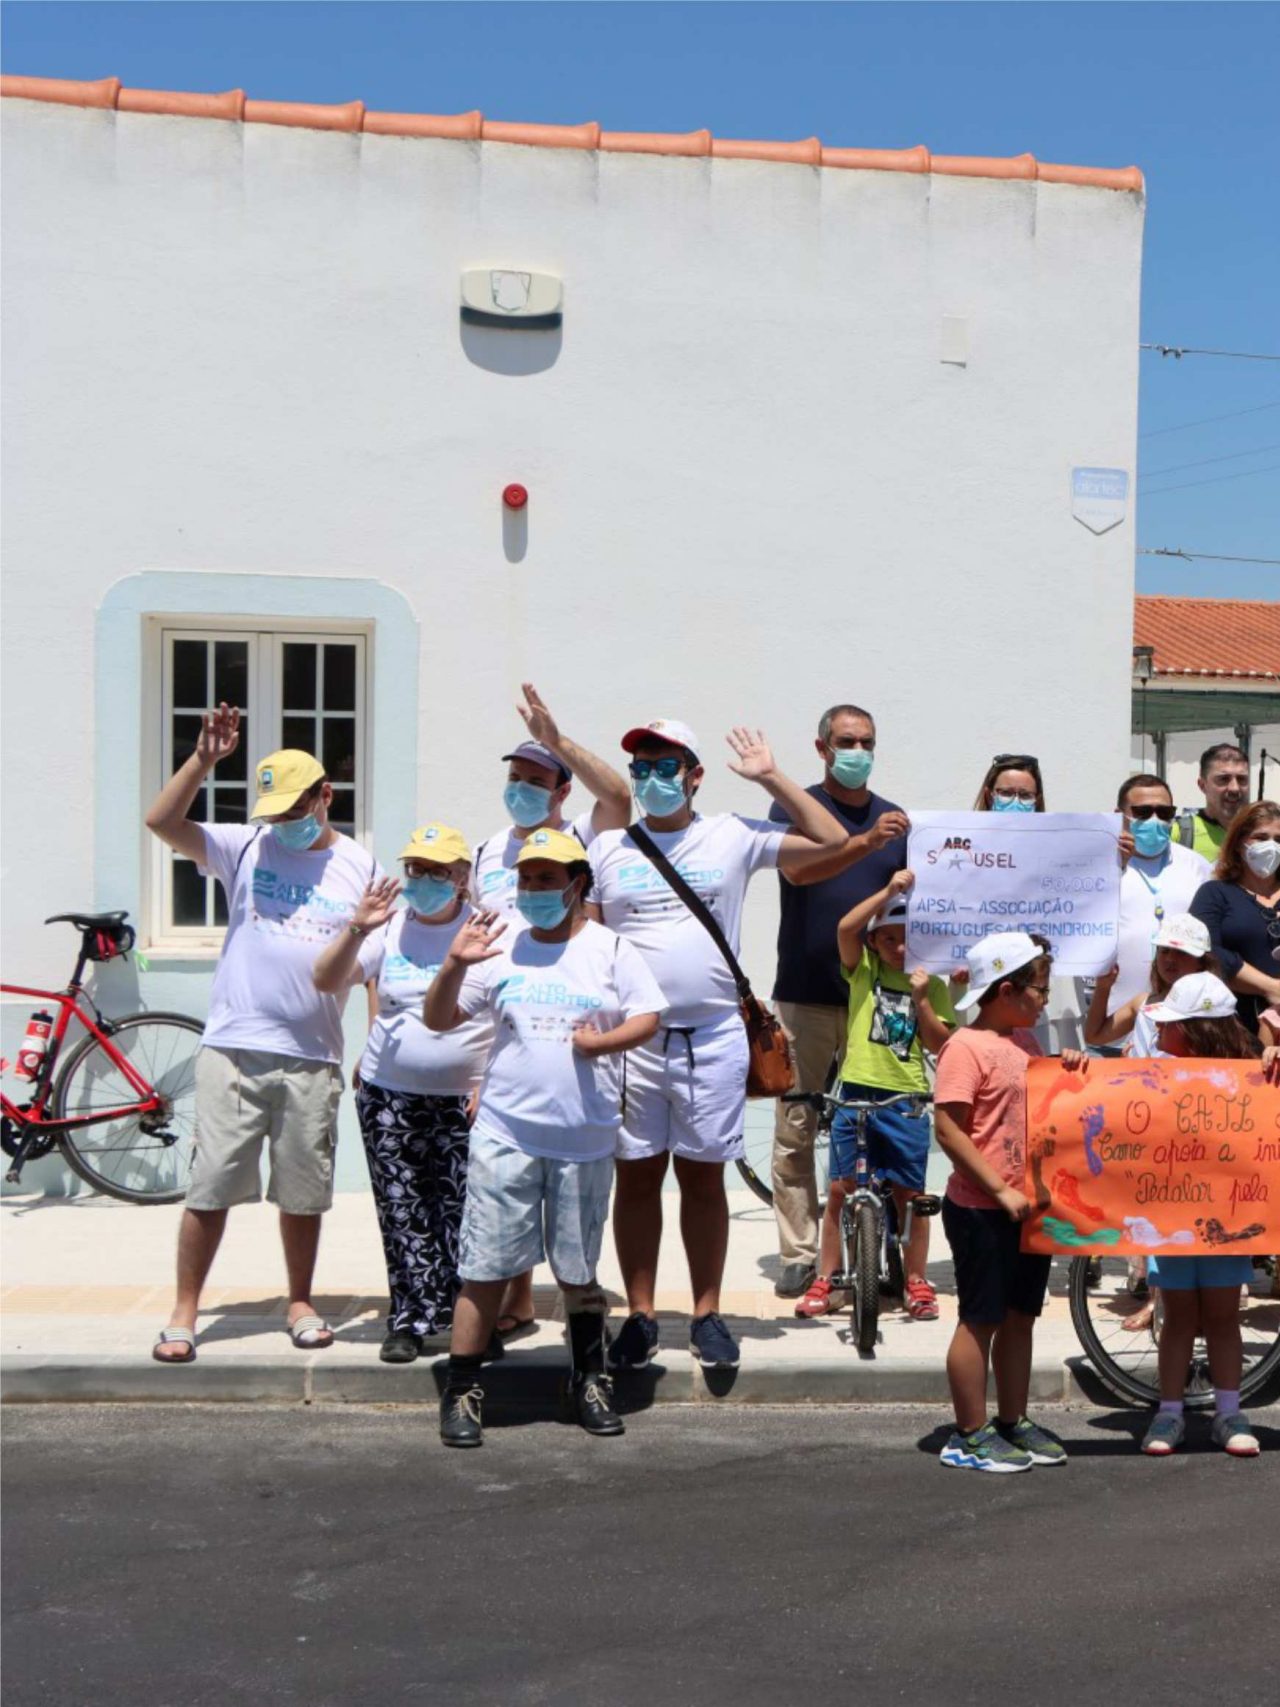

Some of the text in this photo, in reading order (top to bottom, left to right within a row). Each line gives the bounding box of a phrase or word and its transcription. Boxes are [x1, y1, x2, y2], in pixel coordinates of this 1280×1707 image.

[917, 899, 957, 914] APSA
[979, 897, 1074, 918] ASSOCIAÇÃO
[1125, 1100, 1152, 1135] O
[1174, 1093, 1255, 1134] CATL
[1153, 1138, 1209, 1177] apoia
[1217, 1143, 1236, 1162] a
[1229, 1172, 1270, 1217] pela
